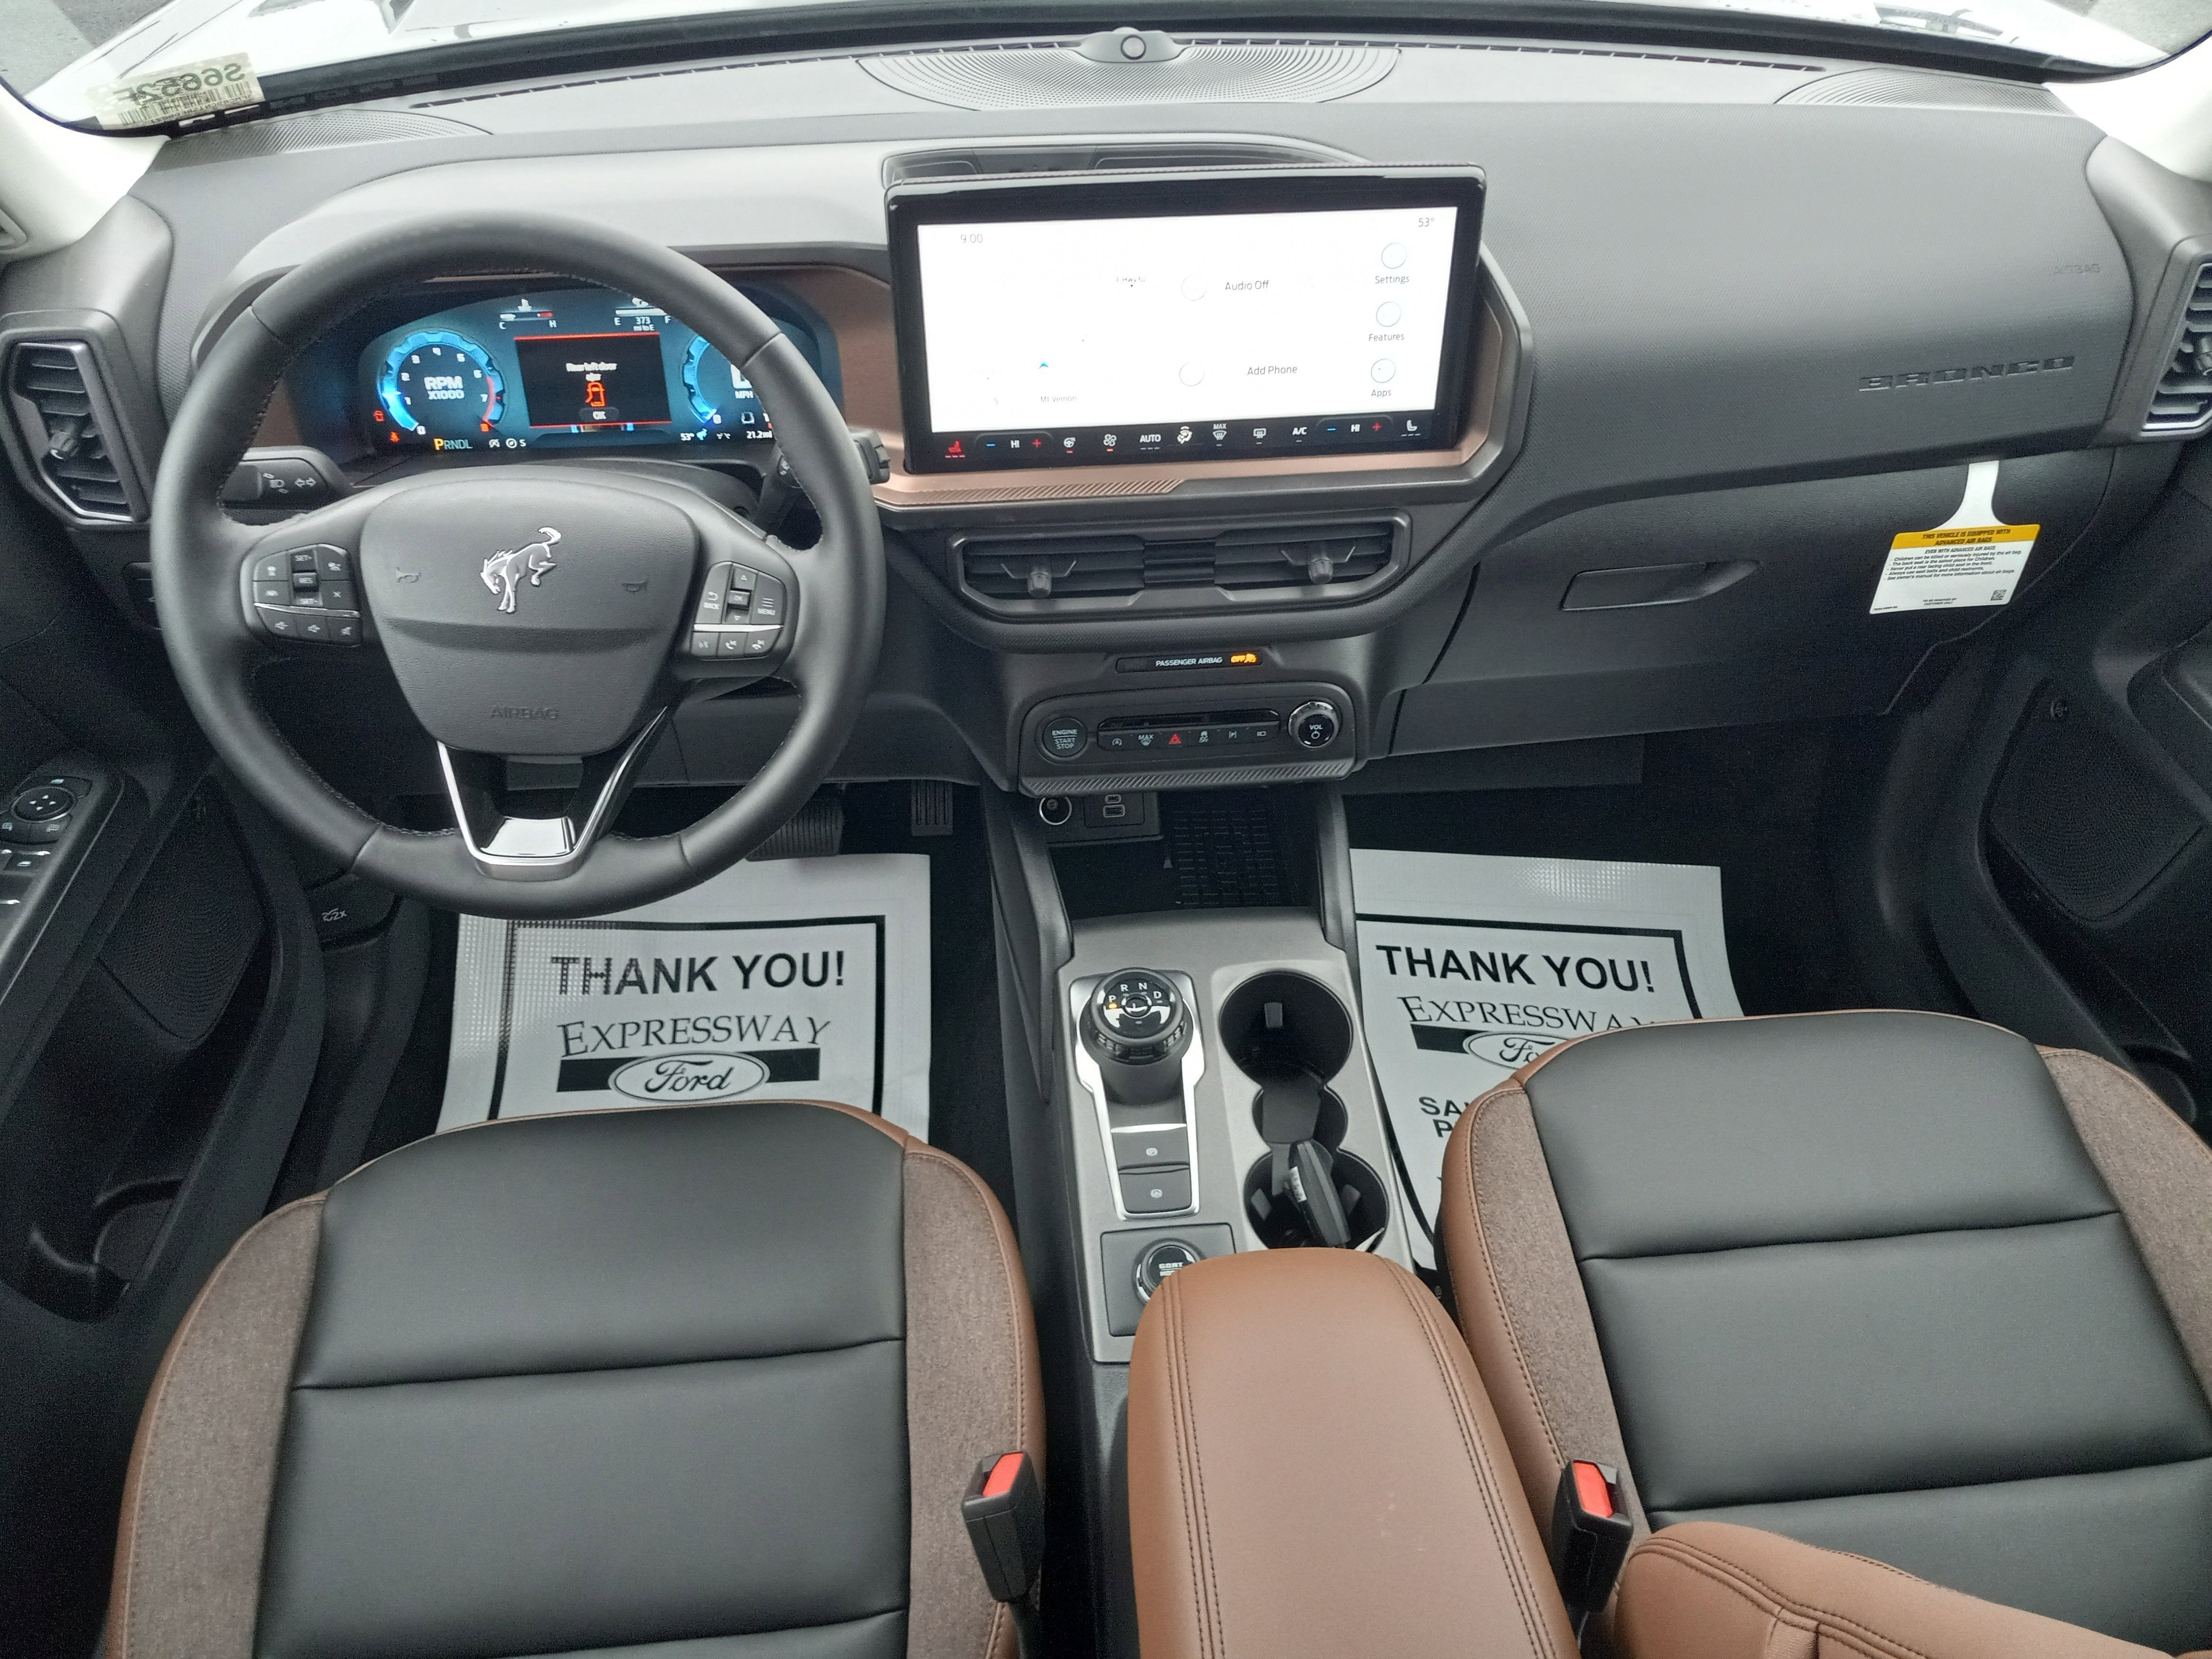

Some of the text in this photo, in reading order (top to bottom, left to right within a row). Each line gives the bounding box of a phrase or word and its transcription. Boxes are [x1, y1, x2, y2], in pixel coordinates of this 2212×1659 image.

[1374, 275, 1409, 284] Settings
[1225, 280, 1269, 291] Audio Off
[549, 320, 557, 328] H
[614, 315, 671, 325] E F
[635, 316, 651, 325] 373
[1369, 333, 1405, 342] Features
[433, 348, 441, 356] 4
[412, 355, 420, 364] 3
[457, 354, 465, 362] 5
[474, 370, 482, 378] 6
[1247, 365, 1298, 375] Add Phone
[1858, 355, 2076, 391] BRONCO
[401, 373, 410, 381] 2
[424, 376, 463, 390] RPM
[735, 391, 753, 399] MPH
[1371, 389, 1392, 397] Apps
[481, 394, 488, 402] 7
[1292, 426, 1308, 436] A/C
[1351, 423, 1360, 432] HI
[1140, 434, 1161, 443] AUTO
[1011, 440, 1020, 448] HI
[1155, 658, 1197, 667] PASSENGER
[492, 706, 558, 720] AIRBAG
[550, 950, 845, 995] THANK YOU!
[1375, 944, 1655, 993] THANK YOU!
[1138, 982, 1148, 990] N
[644, 1059, 734, 1094] Ford
